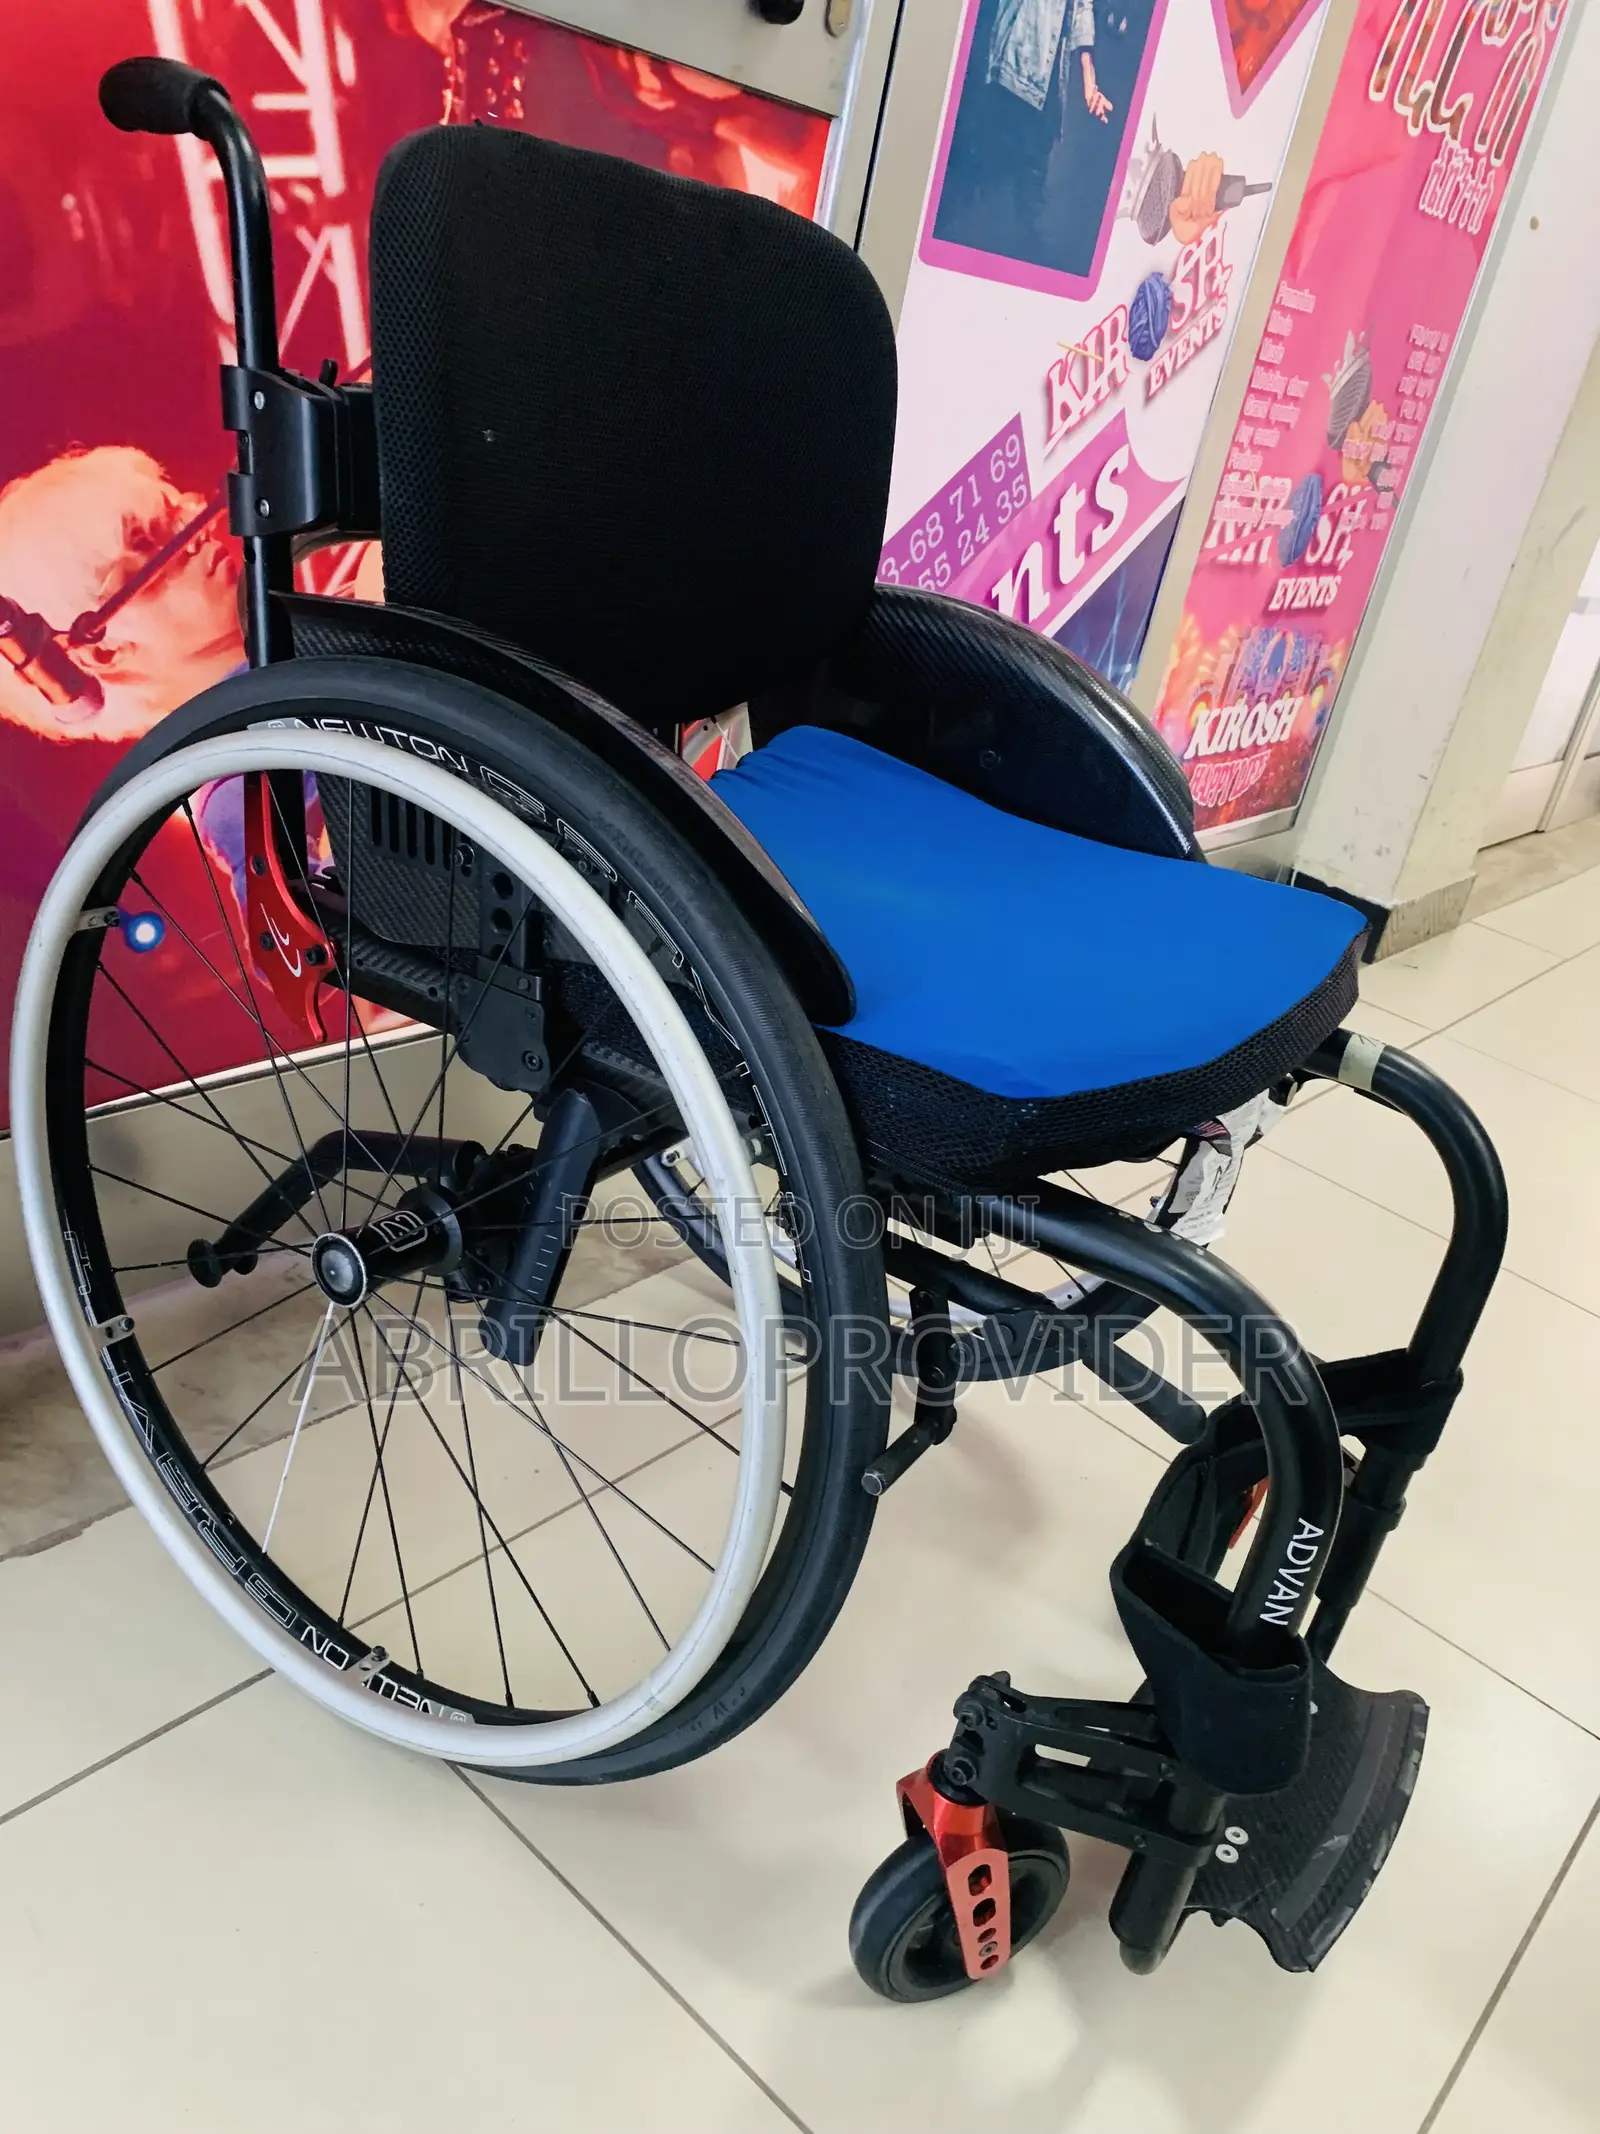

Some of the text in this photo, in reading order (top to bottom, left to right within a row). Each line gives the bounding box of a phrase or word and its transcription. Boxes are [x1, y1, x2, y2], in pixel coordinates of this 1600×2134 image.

[1147, 297, 1229, 398] EVENTS
[875, 434, 1020, 583] 3-68 71 69
[958, 513, 990, 566] 24
[997, 472, 1028, 525] 35
[1268, 575, 1342, 612] EVENTS
[1183, 697, 1304, 760] KIROSH
[1260, 1517, 1324, 1626] ADVAN
[300, 1625, 443, 1719] NEWON
